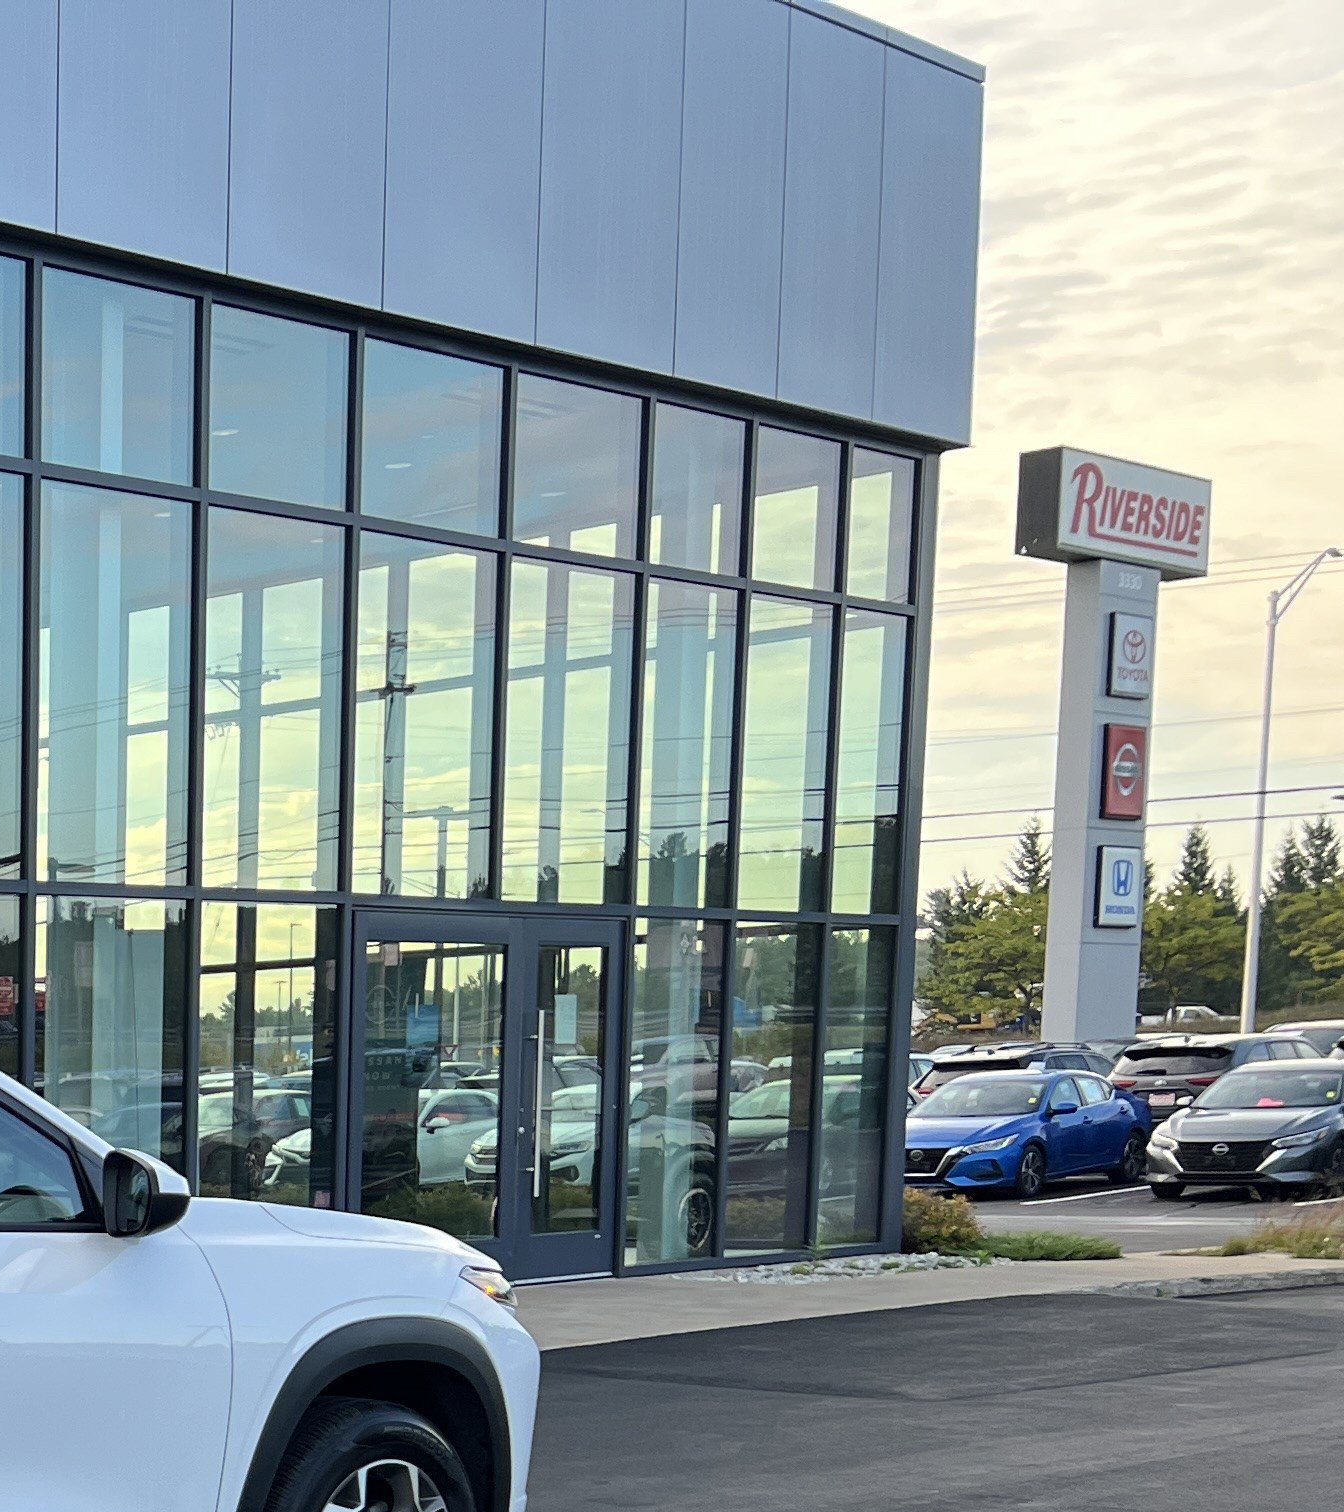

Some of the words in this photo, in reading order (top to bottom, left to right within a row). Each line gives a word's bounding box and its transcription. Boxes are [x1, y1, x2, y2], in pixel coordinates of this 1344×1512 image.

[1070, 462, 1206, 550] RIVERSIDE
[1116, 666, 1149, 682] TOYOTA
[1104, 904, 1135, 915] HONDA
